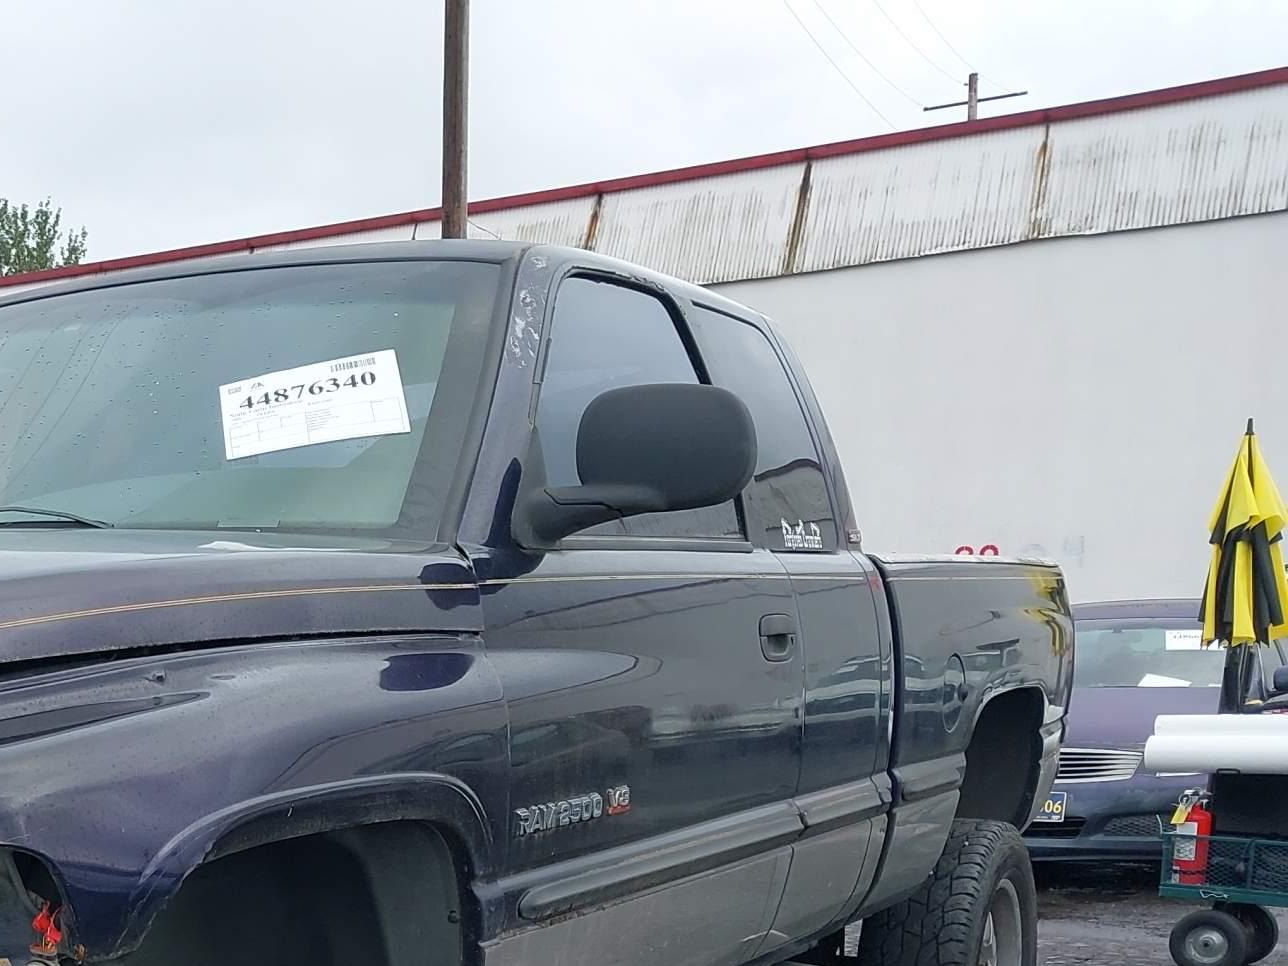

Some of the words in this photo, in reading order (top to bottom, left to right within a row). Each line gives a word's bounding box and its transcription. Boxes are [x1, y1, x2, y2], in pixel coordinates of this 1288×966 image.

[239, 371, 376, 409] 44876340
[513, 802, 557, 835] RAM
[557, 792, 603, 825] 2500
